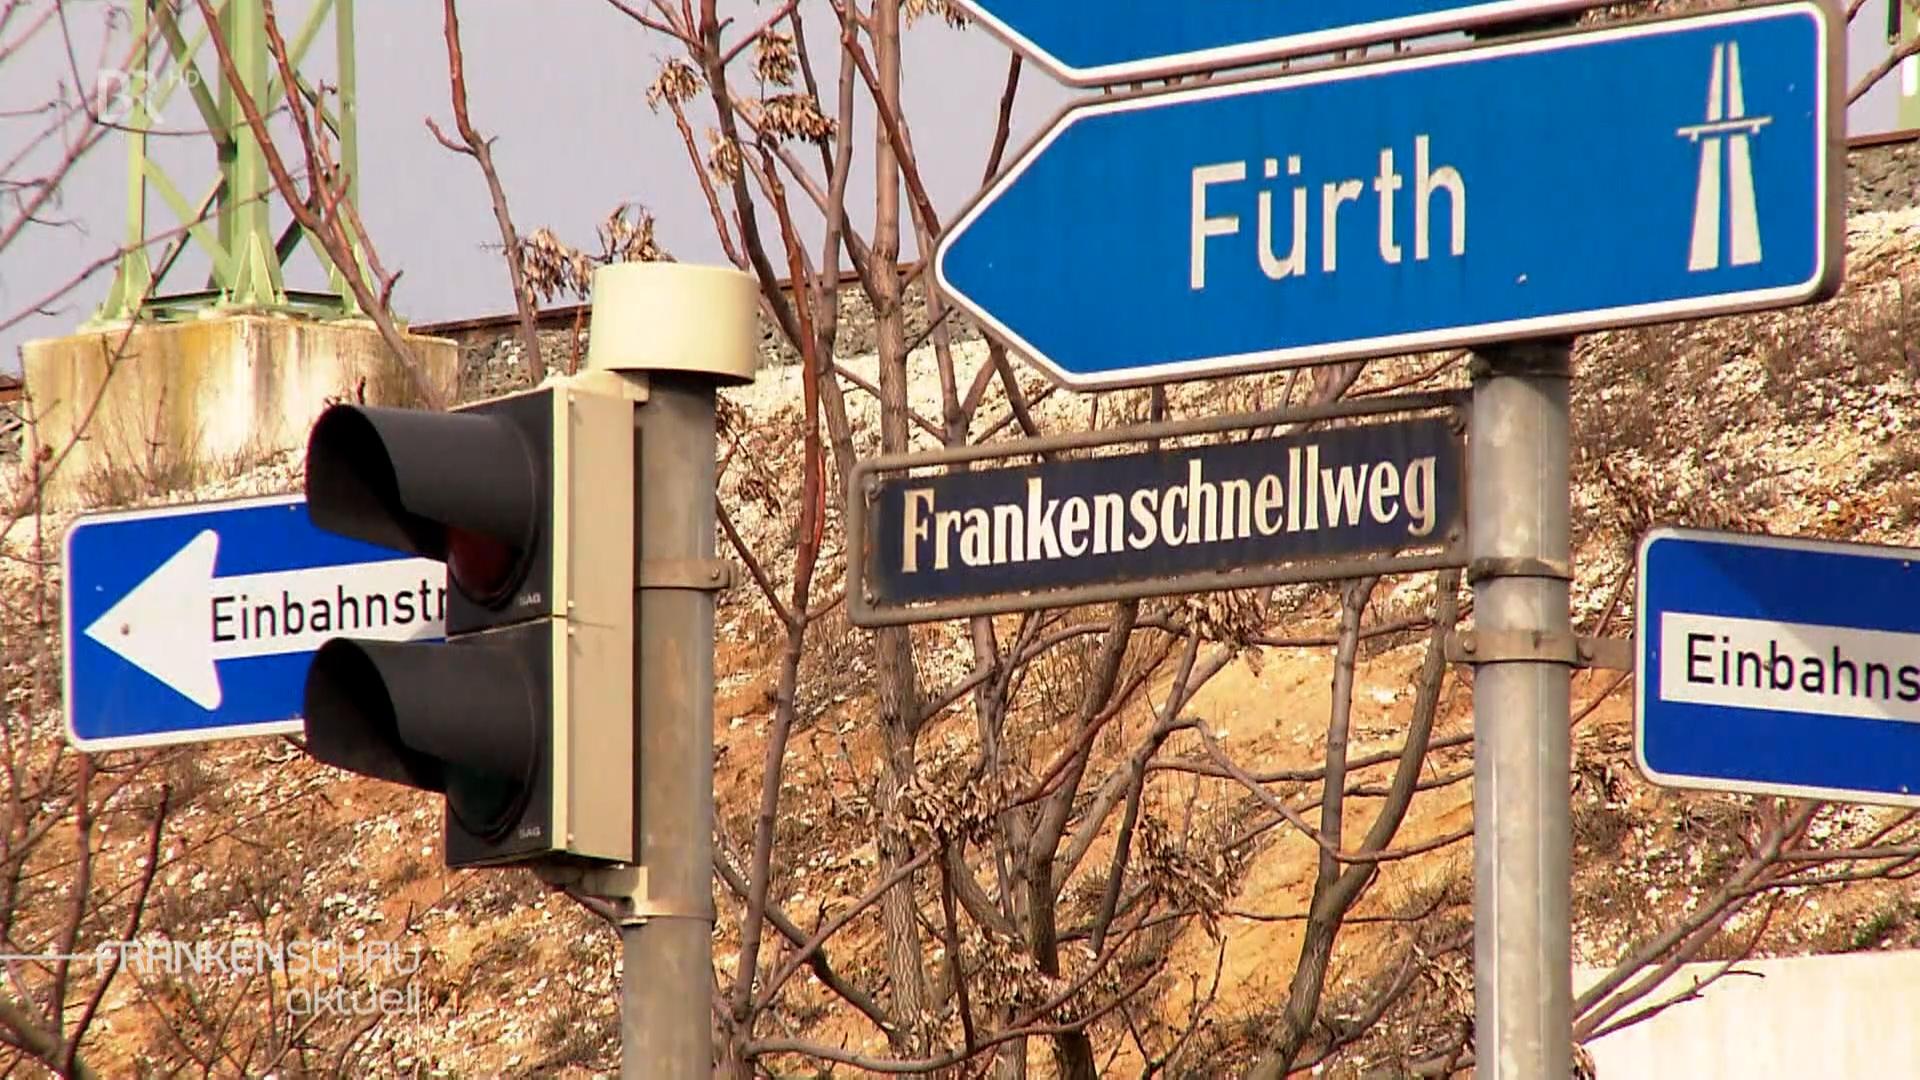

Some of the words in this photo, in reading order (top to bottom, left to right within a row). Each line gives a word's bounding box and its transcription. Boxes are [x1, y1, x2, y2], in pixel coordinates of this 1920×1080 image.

[1191, 134, 1465, 289] Fürth
[901, 444, 1437, 574] Frankenschnellweg
[212, 579, 447, 642] Einbahnstr
[1687, 633, 1920, 702] Einbahns
